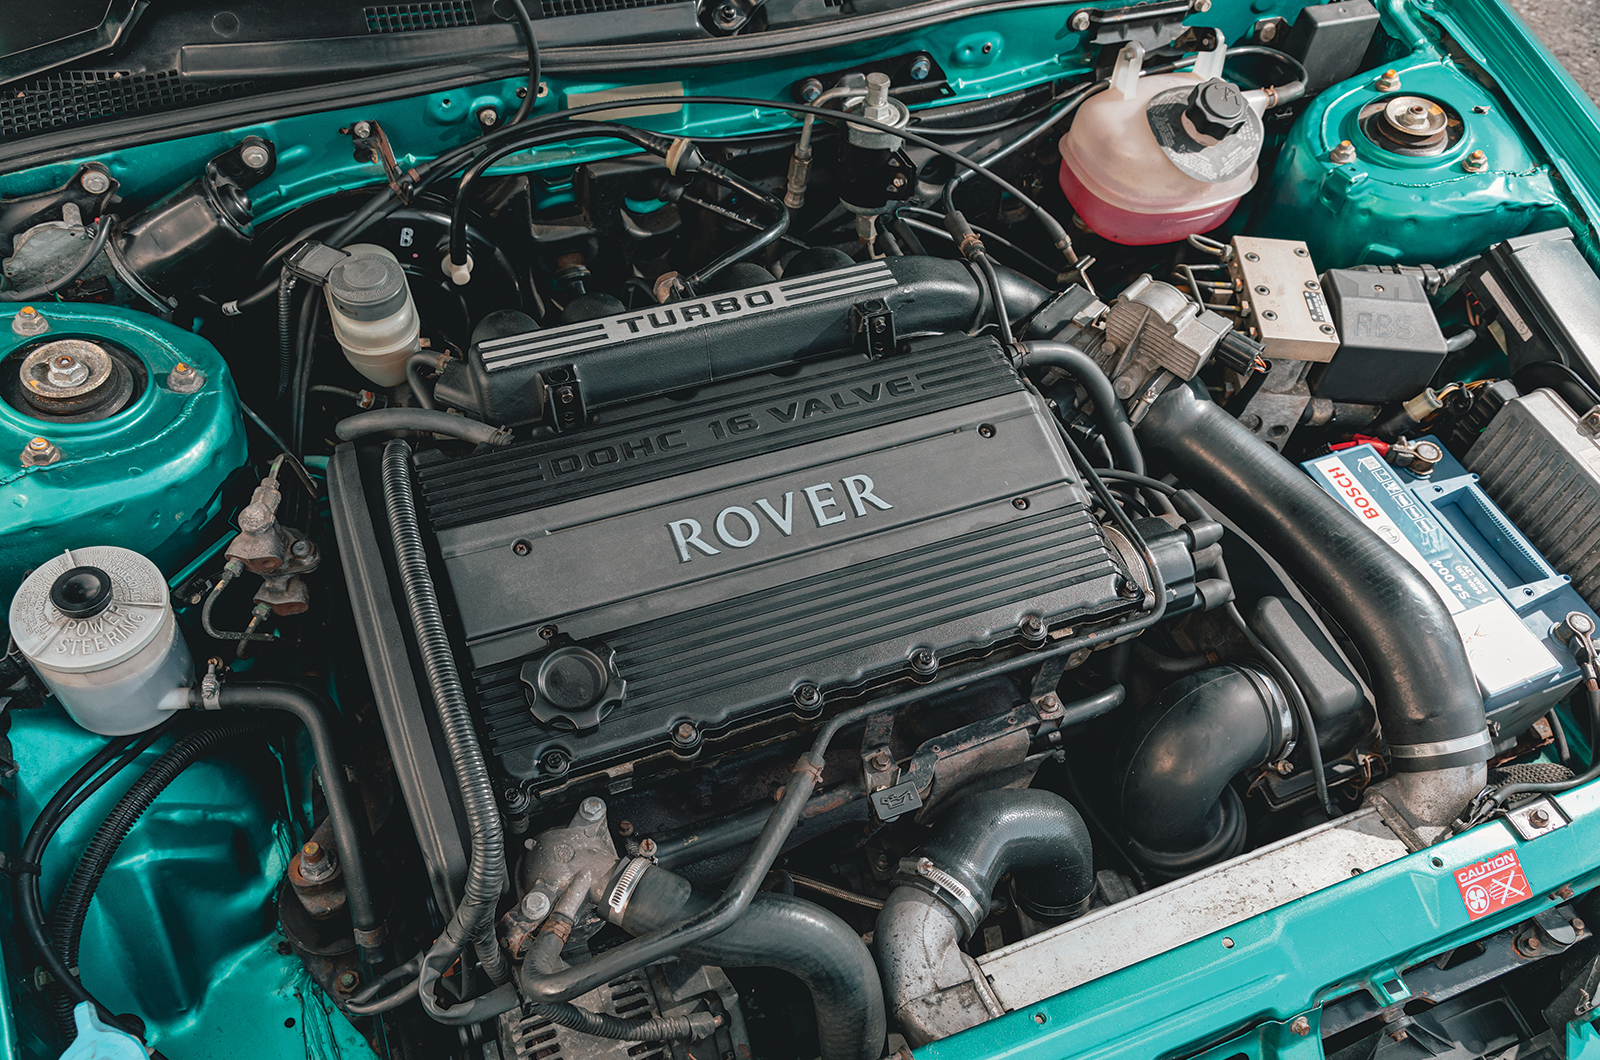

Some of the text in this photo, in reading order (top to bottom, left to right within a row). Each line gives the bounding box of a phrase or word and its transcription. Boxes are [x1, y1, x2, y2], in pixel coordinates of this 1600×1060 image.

[400, 226, 414, 247] B
[616, 289, 775, 334] TURBO
[1355, 312, 1416, 339] ABS
[549, 375, 917, 479] DOHC 16 VALVE
[1327, 465, 1380, 520] BOSCH
[666, 473, 894, 564] ROVER
[1431, 559, 1470, 601] S4 004
[56, 612, 145, 655] STEERING
[63, 604, 128, 637] POWER
[1458, 853, 1515, 883] CAUTION
